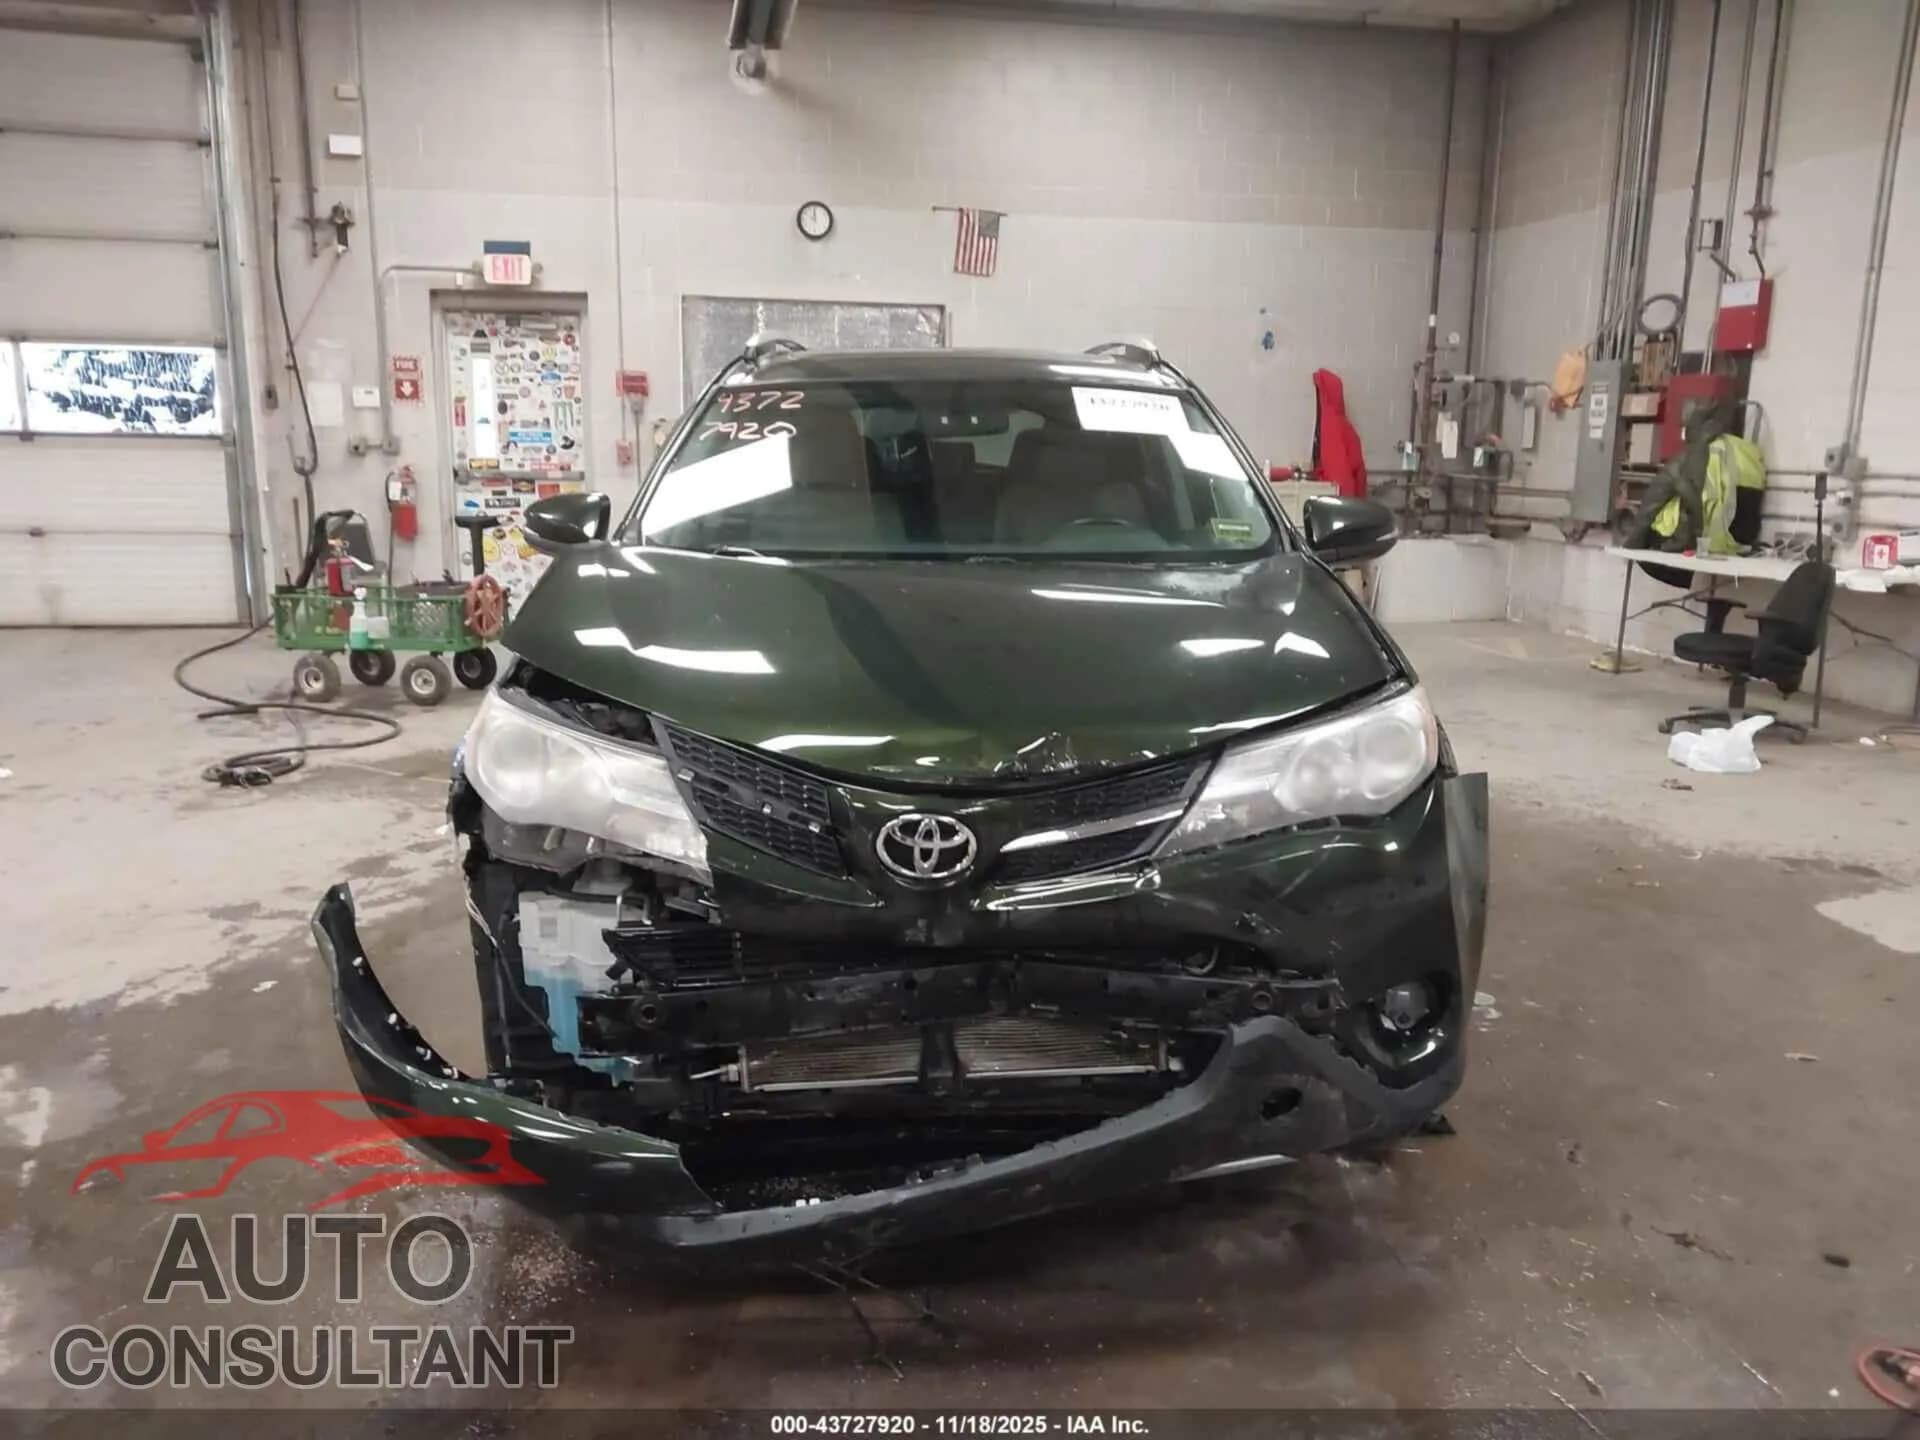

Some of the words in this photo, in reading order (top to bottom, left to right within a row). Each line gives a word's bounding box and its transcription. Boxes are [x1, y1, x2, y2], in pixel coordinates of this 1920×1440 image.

[491, 255, 525, 281] EXIT
[718, 390, 805, 413] 4372
[699, 421, 797, 440] 7920
